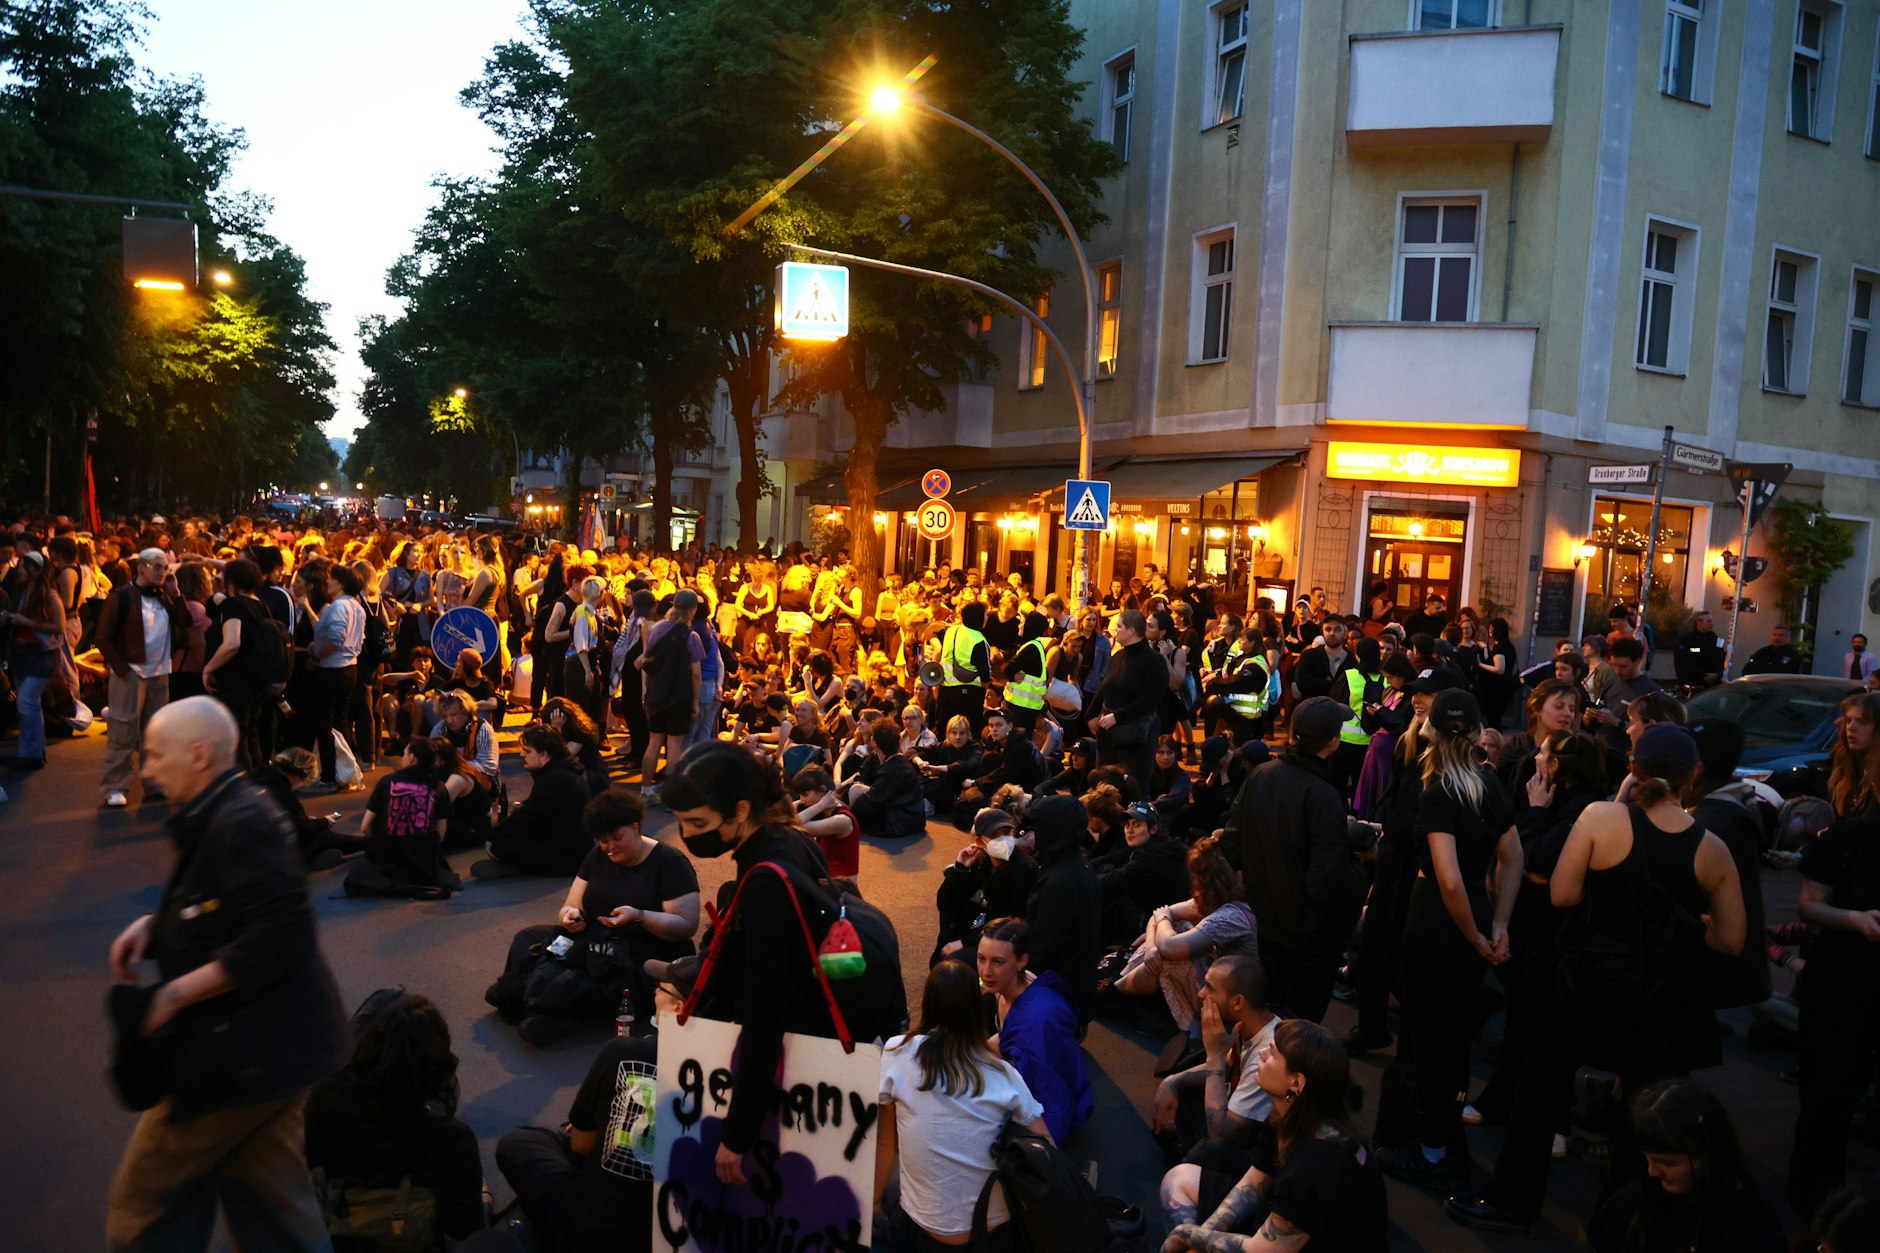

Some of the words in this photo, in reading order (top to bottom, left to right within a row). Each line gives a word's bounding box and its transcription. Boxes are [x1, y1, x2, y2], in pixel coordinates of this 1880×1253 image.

[1594, 468, 1625, 481] Grünberger
[1628, 467, 1647, 478] Straße
[1167, 503, 1190, 514] VELTINS
[925, 511, 947, 528] 30
[673, 1059, 878, 1161] gemany
